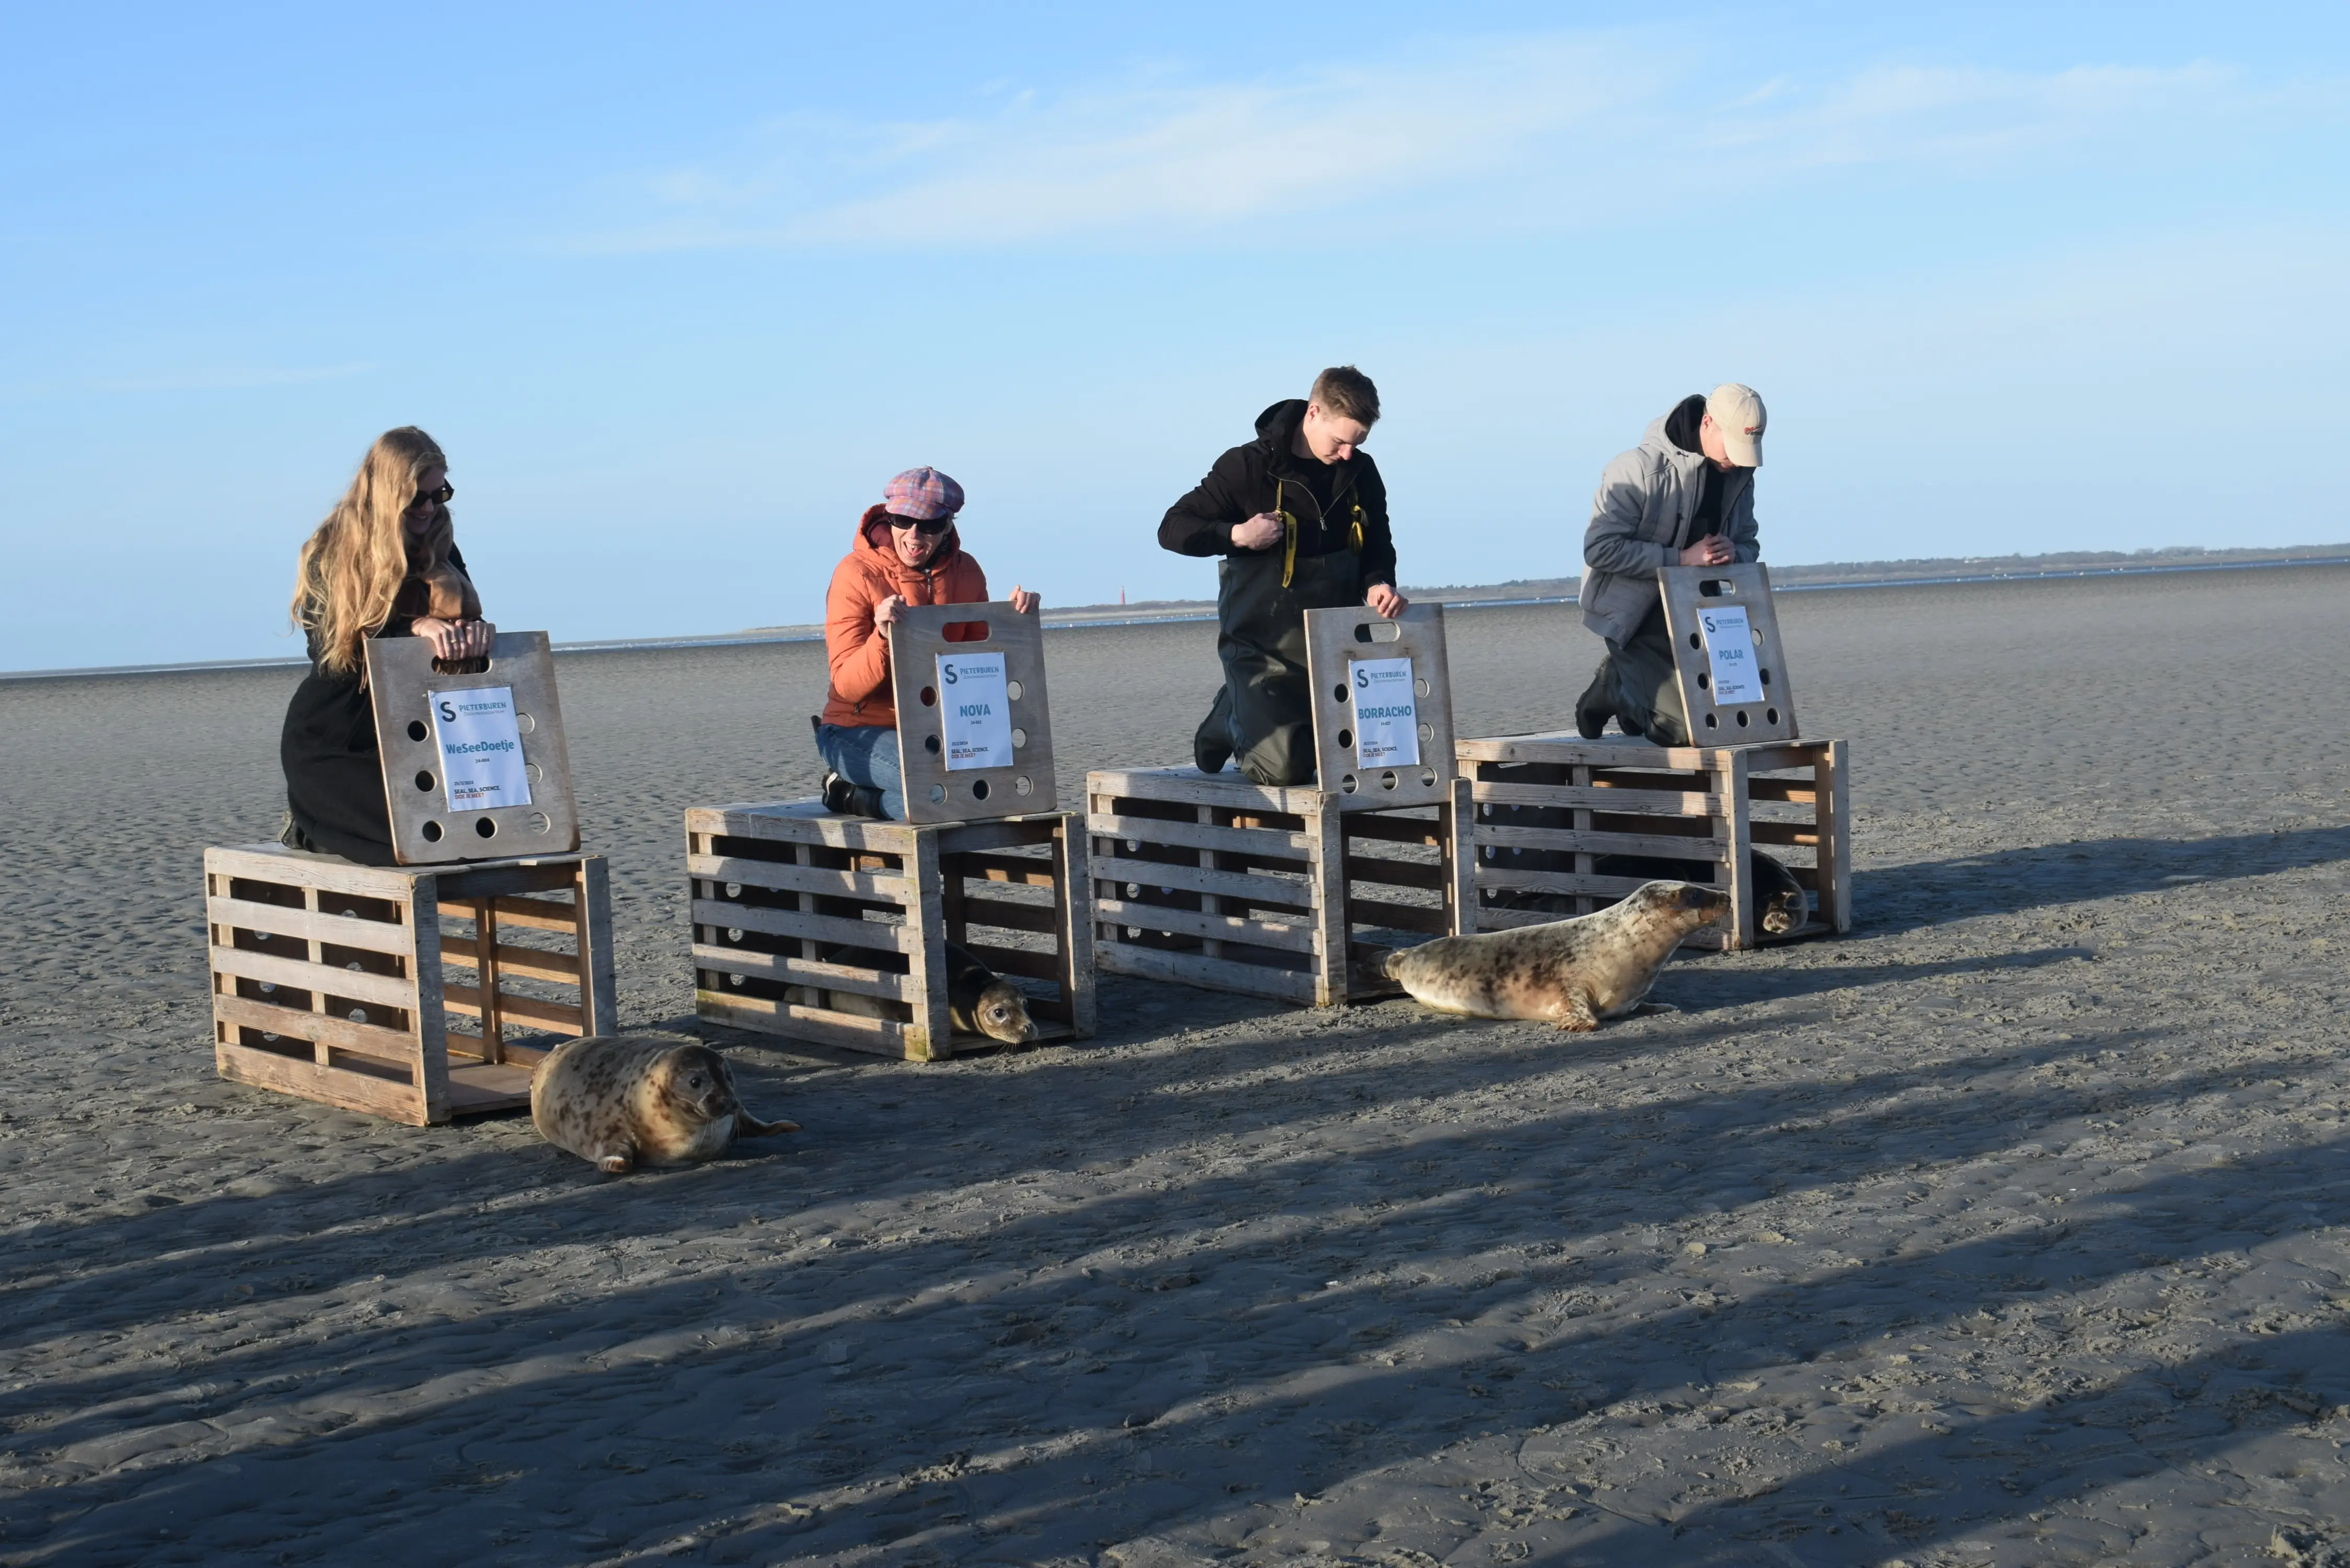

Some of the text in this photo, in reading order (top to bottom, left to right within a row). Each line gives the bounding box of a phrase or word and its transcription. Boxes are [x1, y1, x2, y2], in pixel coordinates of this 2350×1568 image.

[1719, 649, 1744, 660] POLAR
[960, 666, 999, 675] PIETERBUREN
[1370, 671, 1406, 679] PIETERBUREN
[459, 702, 506, 711] PIETERBUREN
[960, 704, 991, 717] NOVA
[1358, 706, 1412, 719] BORRACHO
[445, 740, 515, 754] WeSeeDoetje
